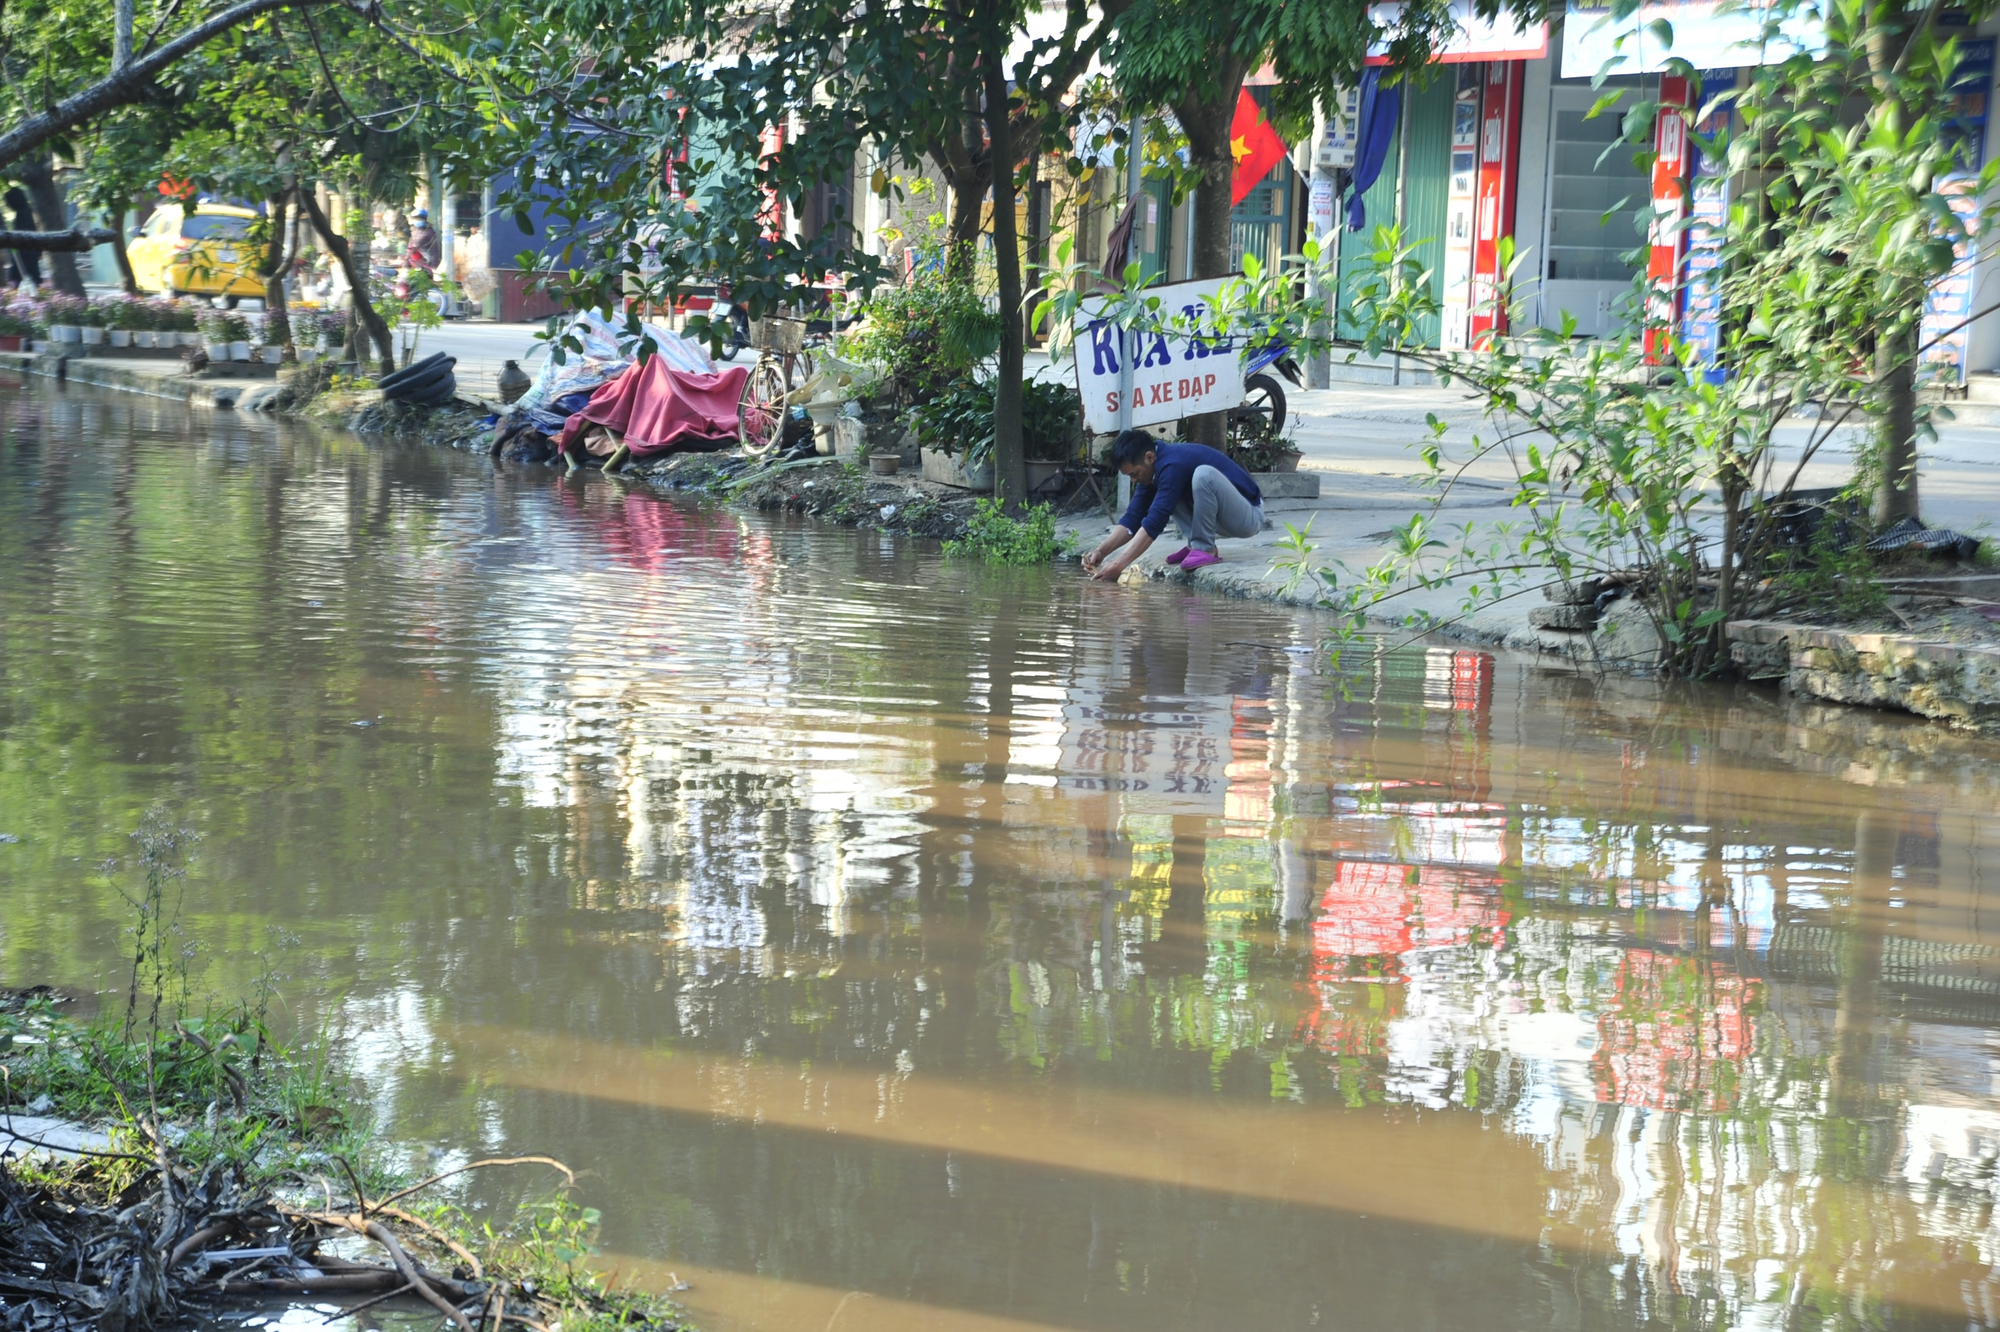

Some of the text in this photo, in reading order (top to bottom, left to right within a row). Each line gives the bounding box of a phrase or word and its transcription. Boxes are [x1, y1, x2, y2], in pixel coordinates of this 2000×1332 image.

[1088, 304, 1171, 376] RA
[1106, 373, 1216, 412] SA XE ĐẠP
